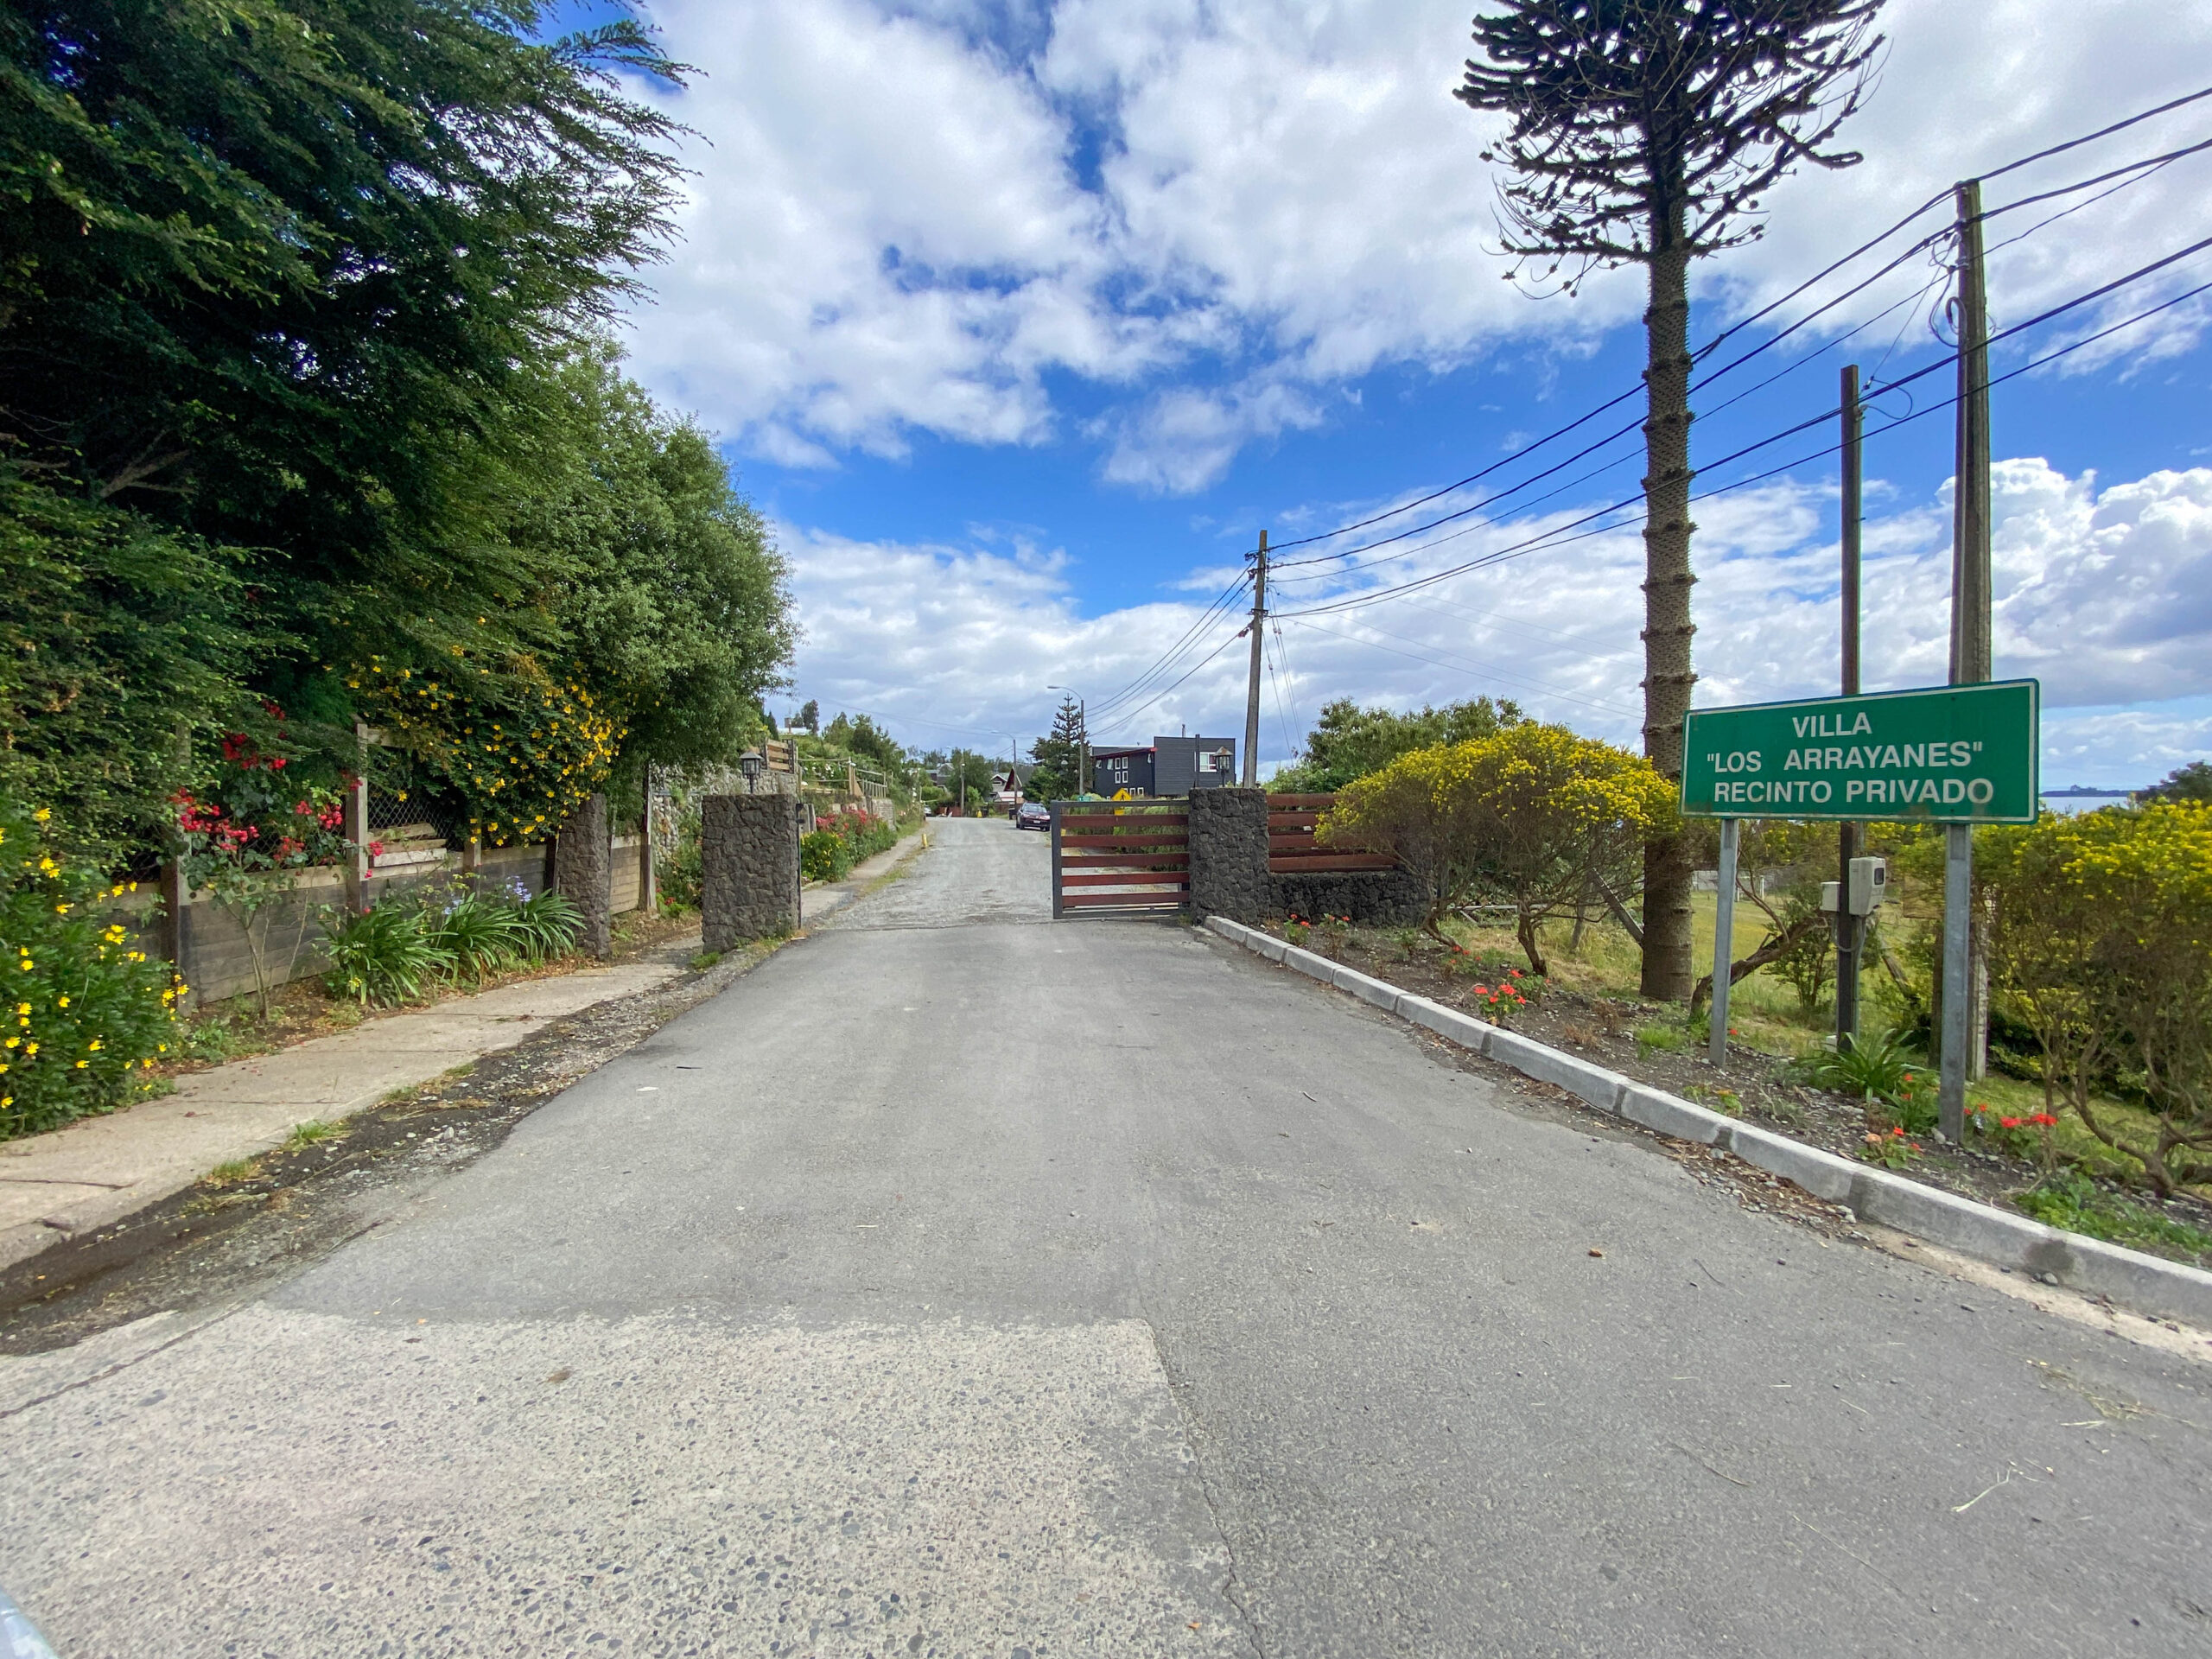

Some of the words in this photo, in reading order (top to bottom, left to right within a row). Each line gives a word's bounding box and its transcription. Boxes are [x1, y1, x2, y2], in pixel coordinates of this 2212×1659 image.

[1792, 712, 1872, 738] VILLA
[1707, 750, 1762, 773] "LOS
[1783, 741, 1983, 771] ARRAYANES"
[1714, 780, 1833, 804] RECINTO
[1846, 778, 1994, 804] PRIVADO
